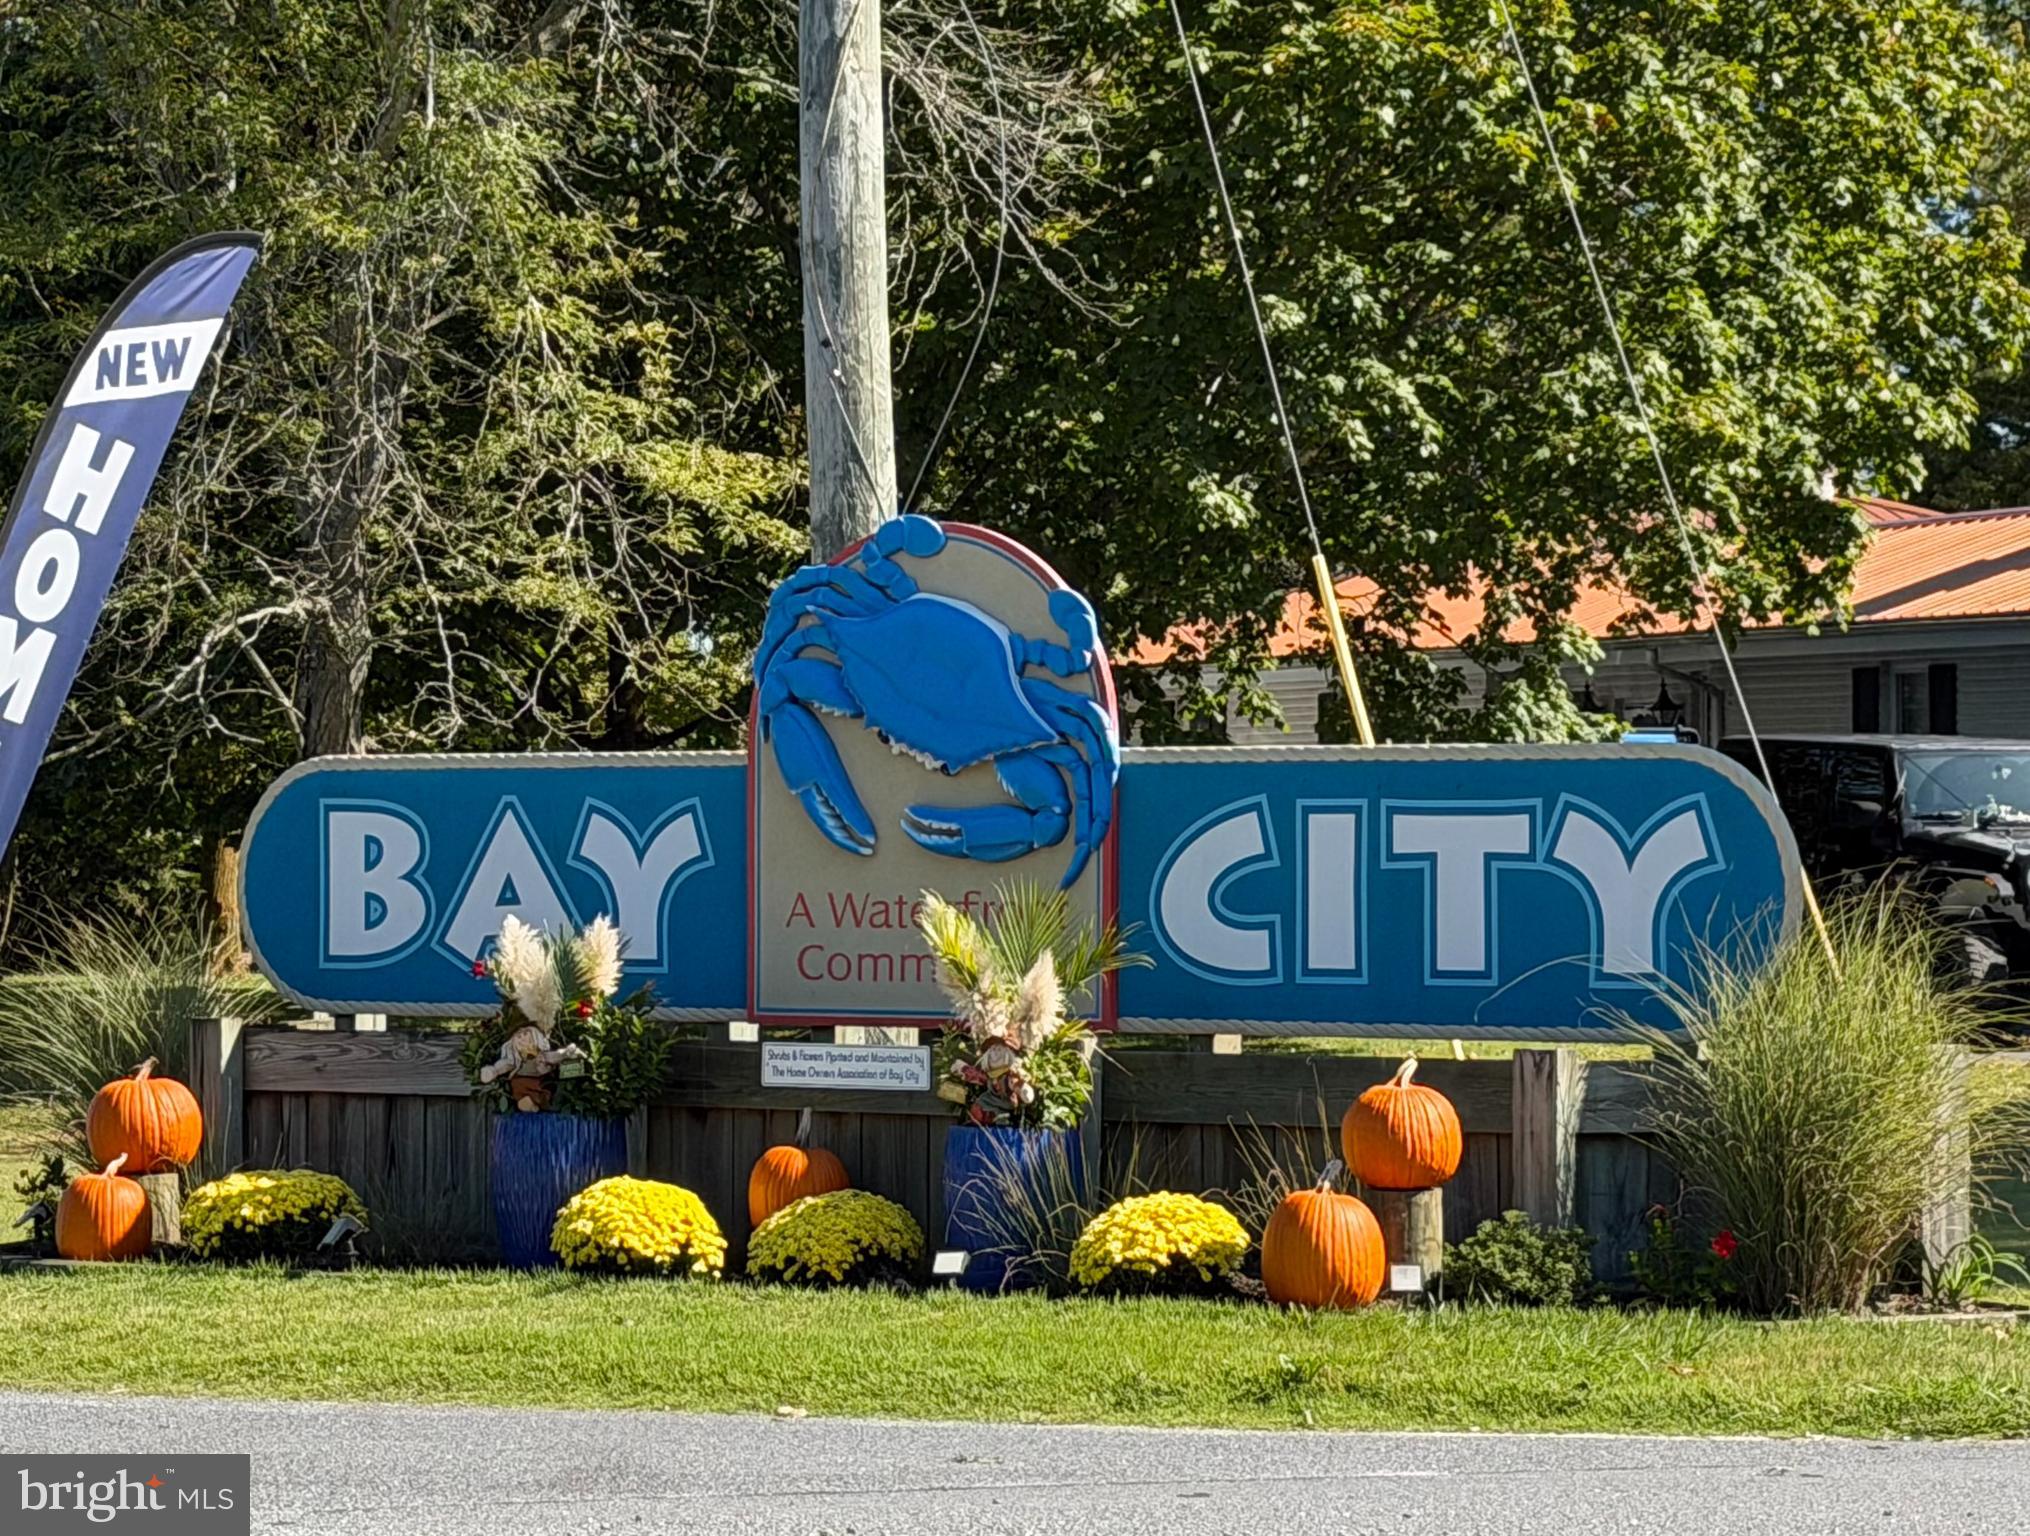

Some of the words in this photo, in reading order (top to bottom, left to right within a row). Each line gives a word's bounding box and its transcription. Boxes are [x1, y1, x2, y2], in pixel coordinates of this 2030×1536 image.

[95, 336, 192, 390] NEW
[319, 795, 715, 974] BAY
[1149, 792, 1726, 988] CITY
[785, 892, 816, 929] A
[771, 1064, 786, 1077] The
[786, 1065, 807, 1078] Home
[837, 1067, 878, 1080] Association
[879, 1068, 888, 1080] of
[888, 1068, 904, 1084] Bay
[904, 1068, 920, 1085] City
[854, 1051, 870, 1063] and
[870, 1051, 914, 1064] Maintained
[914, 1053, 926, 1071] by
